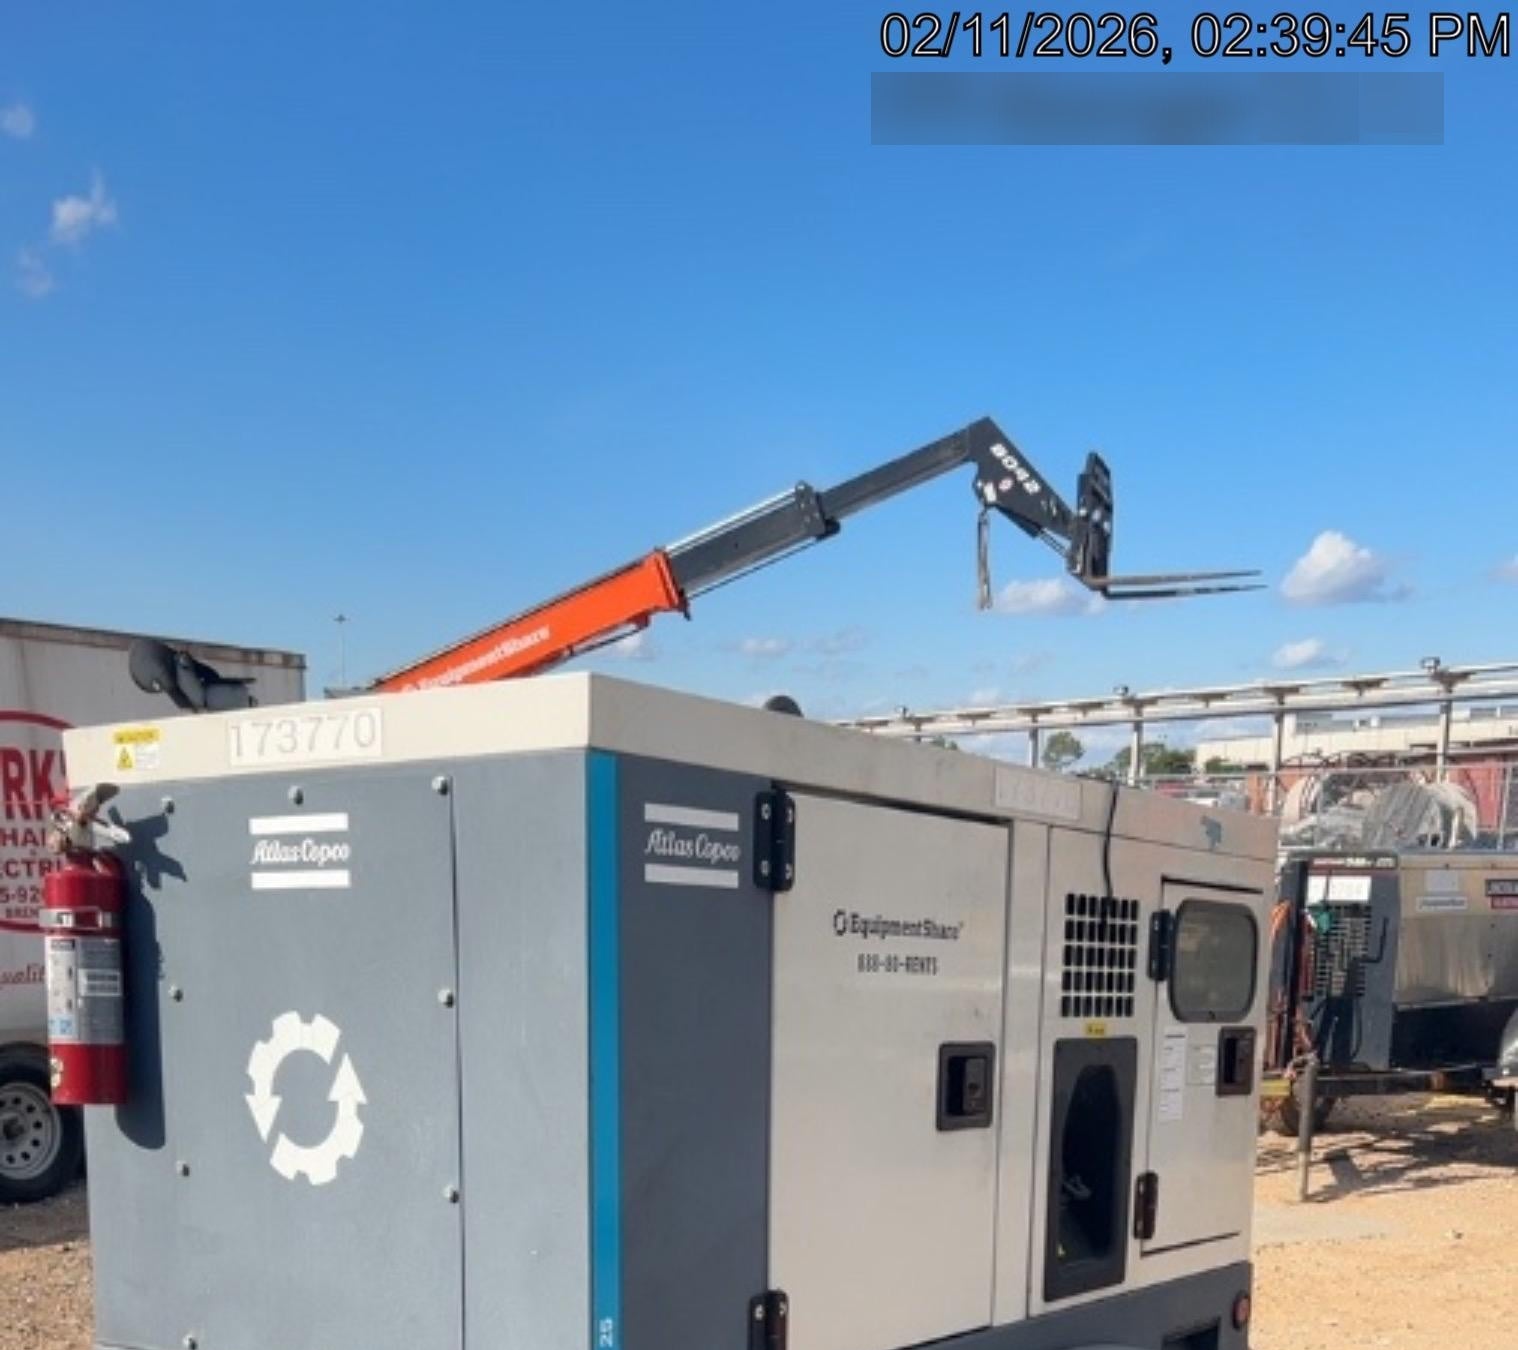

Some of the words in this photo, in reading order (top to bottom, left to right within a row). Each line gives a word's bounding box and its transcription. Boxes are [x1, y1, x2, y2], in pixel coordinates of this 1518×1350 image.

[231, 710, 377, 757] 173770
[249, 839, 299, 865] Atlas
[301, 837, 350, 867] Copco
[645, 828, 694, 857] Atlas
[695, 832, 741, 865] Copco
[599, 1317, 613, 1348] 25
